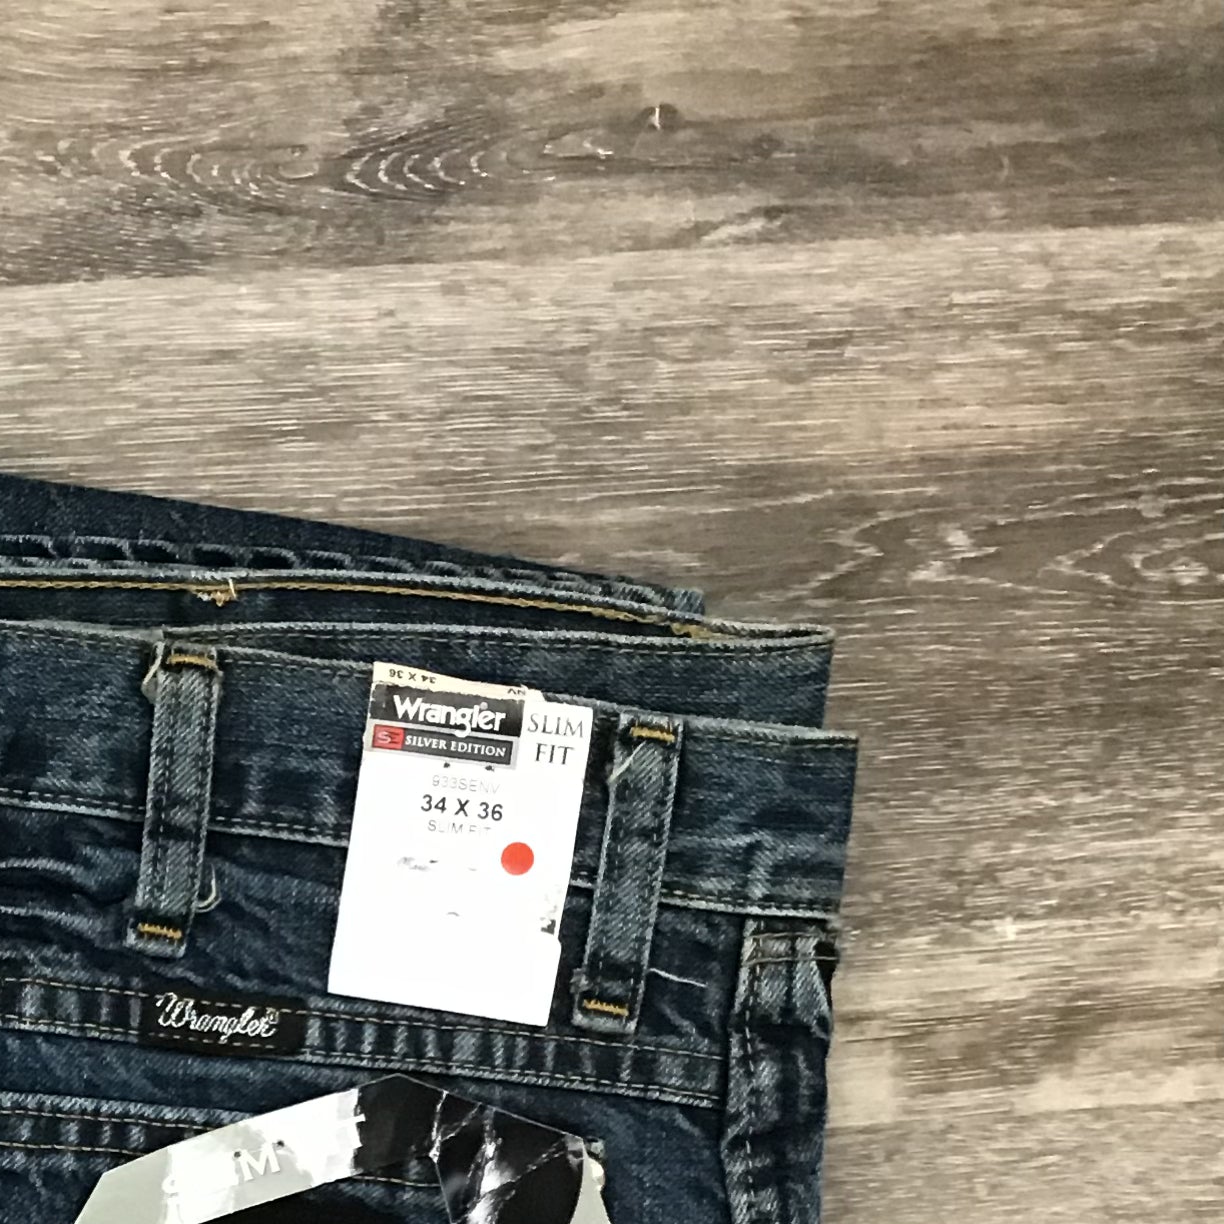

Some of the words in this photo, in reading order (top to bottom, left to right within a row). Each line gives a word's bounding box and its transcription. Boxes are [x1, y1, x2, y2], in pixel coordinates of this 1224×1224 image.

[393, 694, 507, 738] Wrangler
[527, 712, 584, 738] SLIM
[405, 734, 448, 751] SILVER
[450, 740, 507, 758] EDITION
[535, 742, 575, 765] FIT
[421, 794, 447, 814] 34
[454, 798, 470, 817] X
[477, 802, 503, 821] 36
[155, 992, 277, 1044] Wrangler
